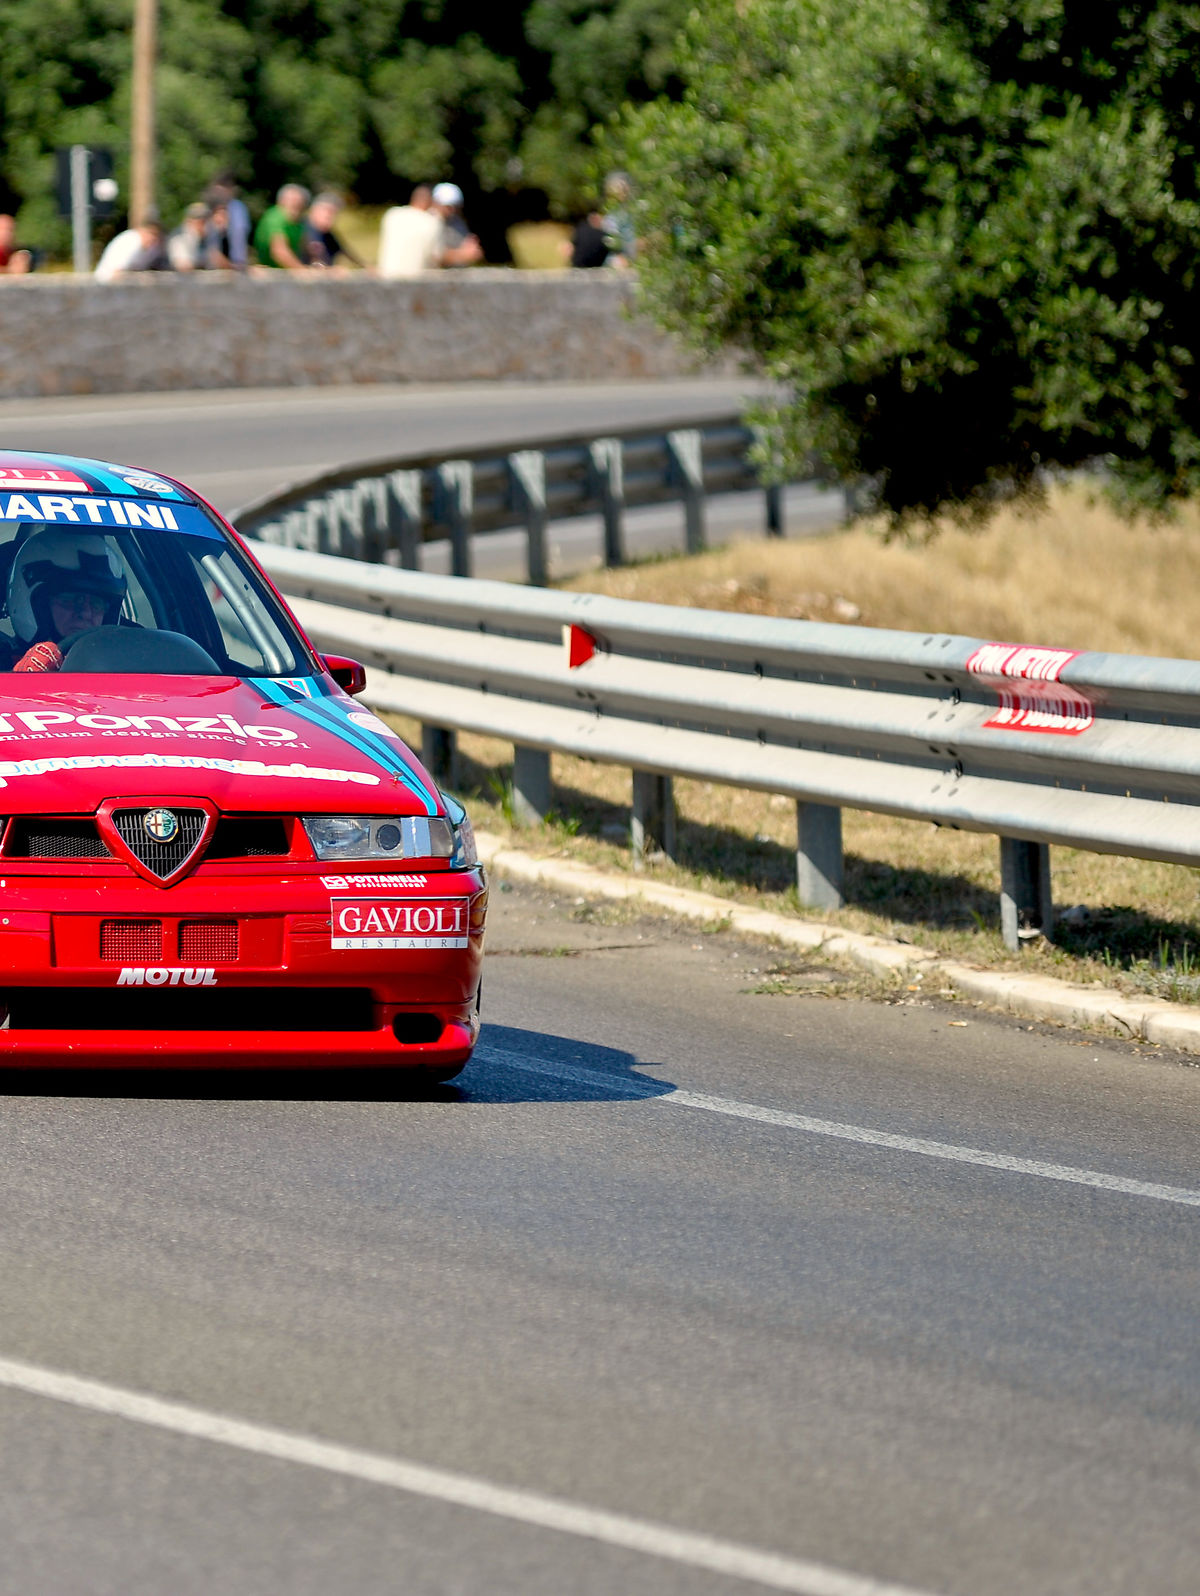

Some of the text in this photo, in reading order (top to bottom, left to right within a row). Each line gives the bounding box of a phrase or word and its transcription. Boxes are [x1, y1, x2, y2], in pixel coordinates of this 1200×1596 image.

[15, 711, 299, 741] Ponzio
[101, 730, 180, 739] design
[187, 731, 247, 747] since
[257, 740, 312, 749] 1941
[345, 875, 428, 884] SOTTANELLI
[338, 907, 463, 933] GAVIOLI
[345, 939, 459, 949] RESTAURI
[117, 968, 218, 986] MOTUL
